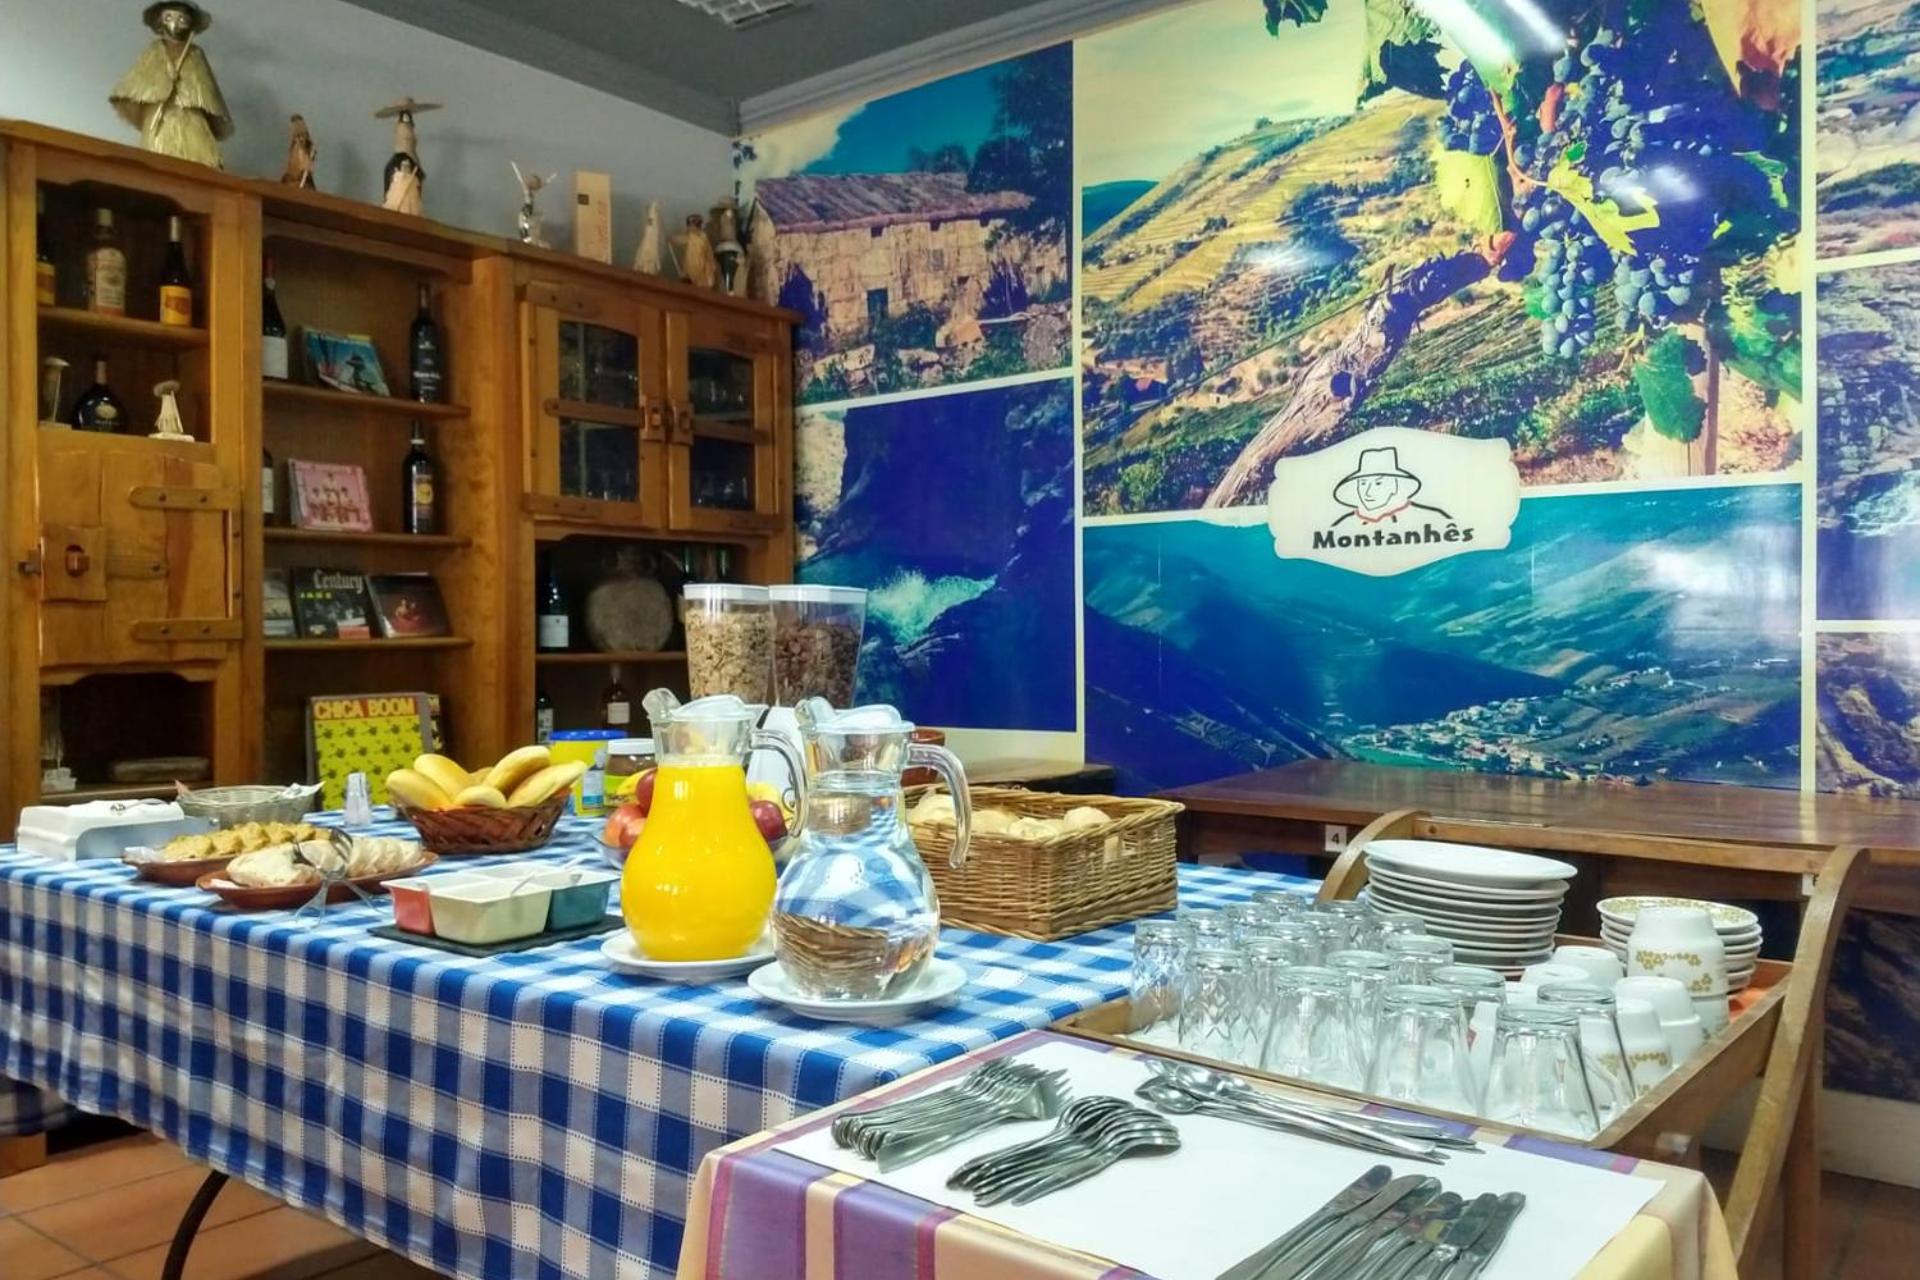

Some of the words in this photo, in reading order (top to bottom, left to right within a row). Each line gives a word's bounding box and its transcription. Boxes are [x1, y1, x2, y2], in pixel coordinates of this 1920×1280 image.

[1313, 523, 1474, 549] Montanhês
[313, 569, 363, 594] Century
[314, 699, 364, 720] CHICA
[367, 697, 415, 718] BOOM
[1332, 833, 1340, 844] 4
